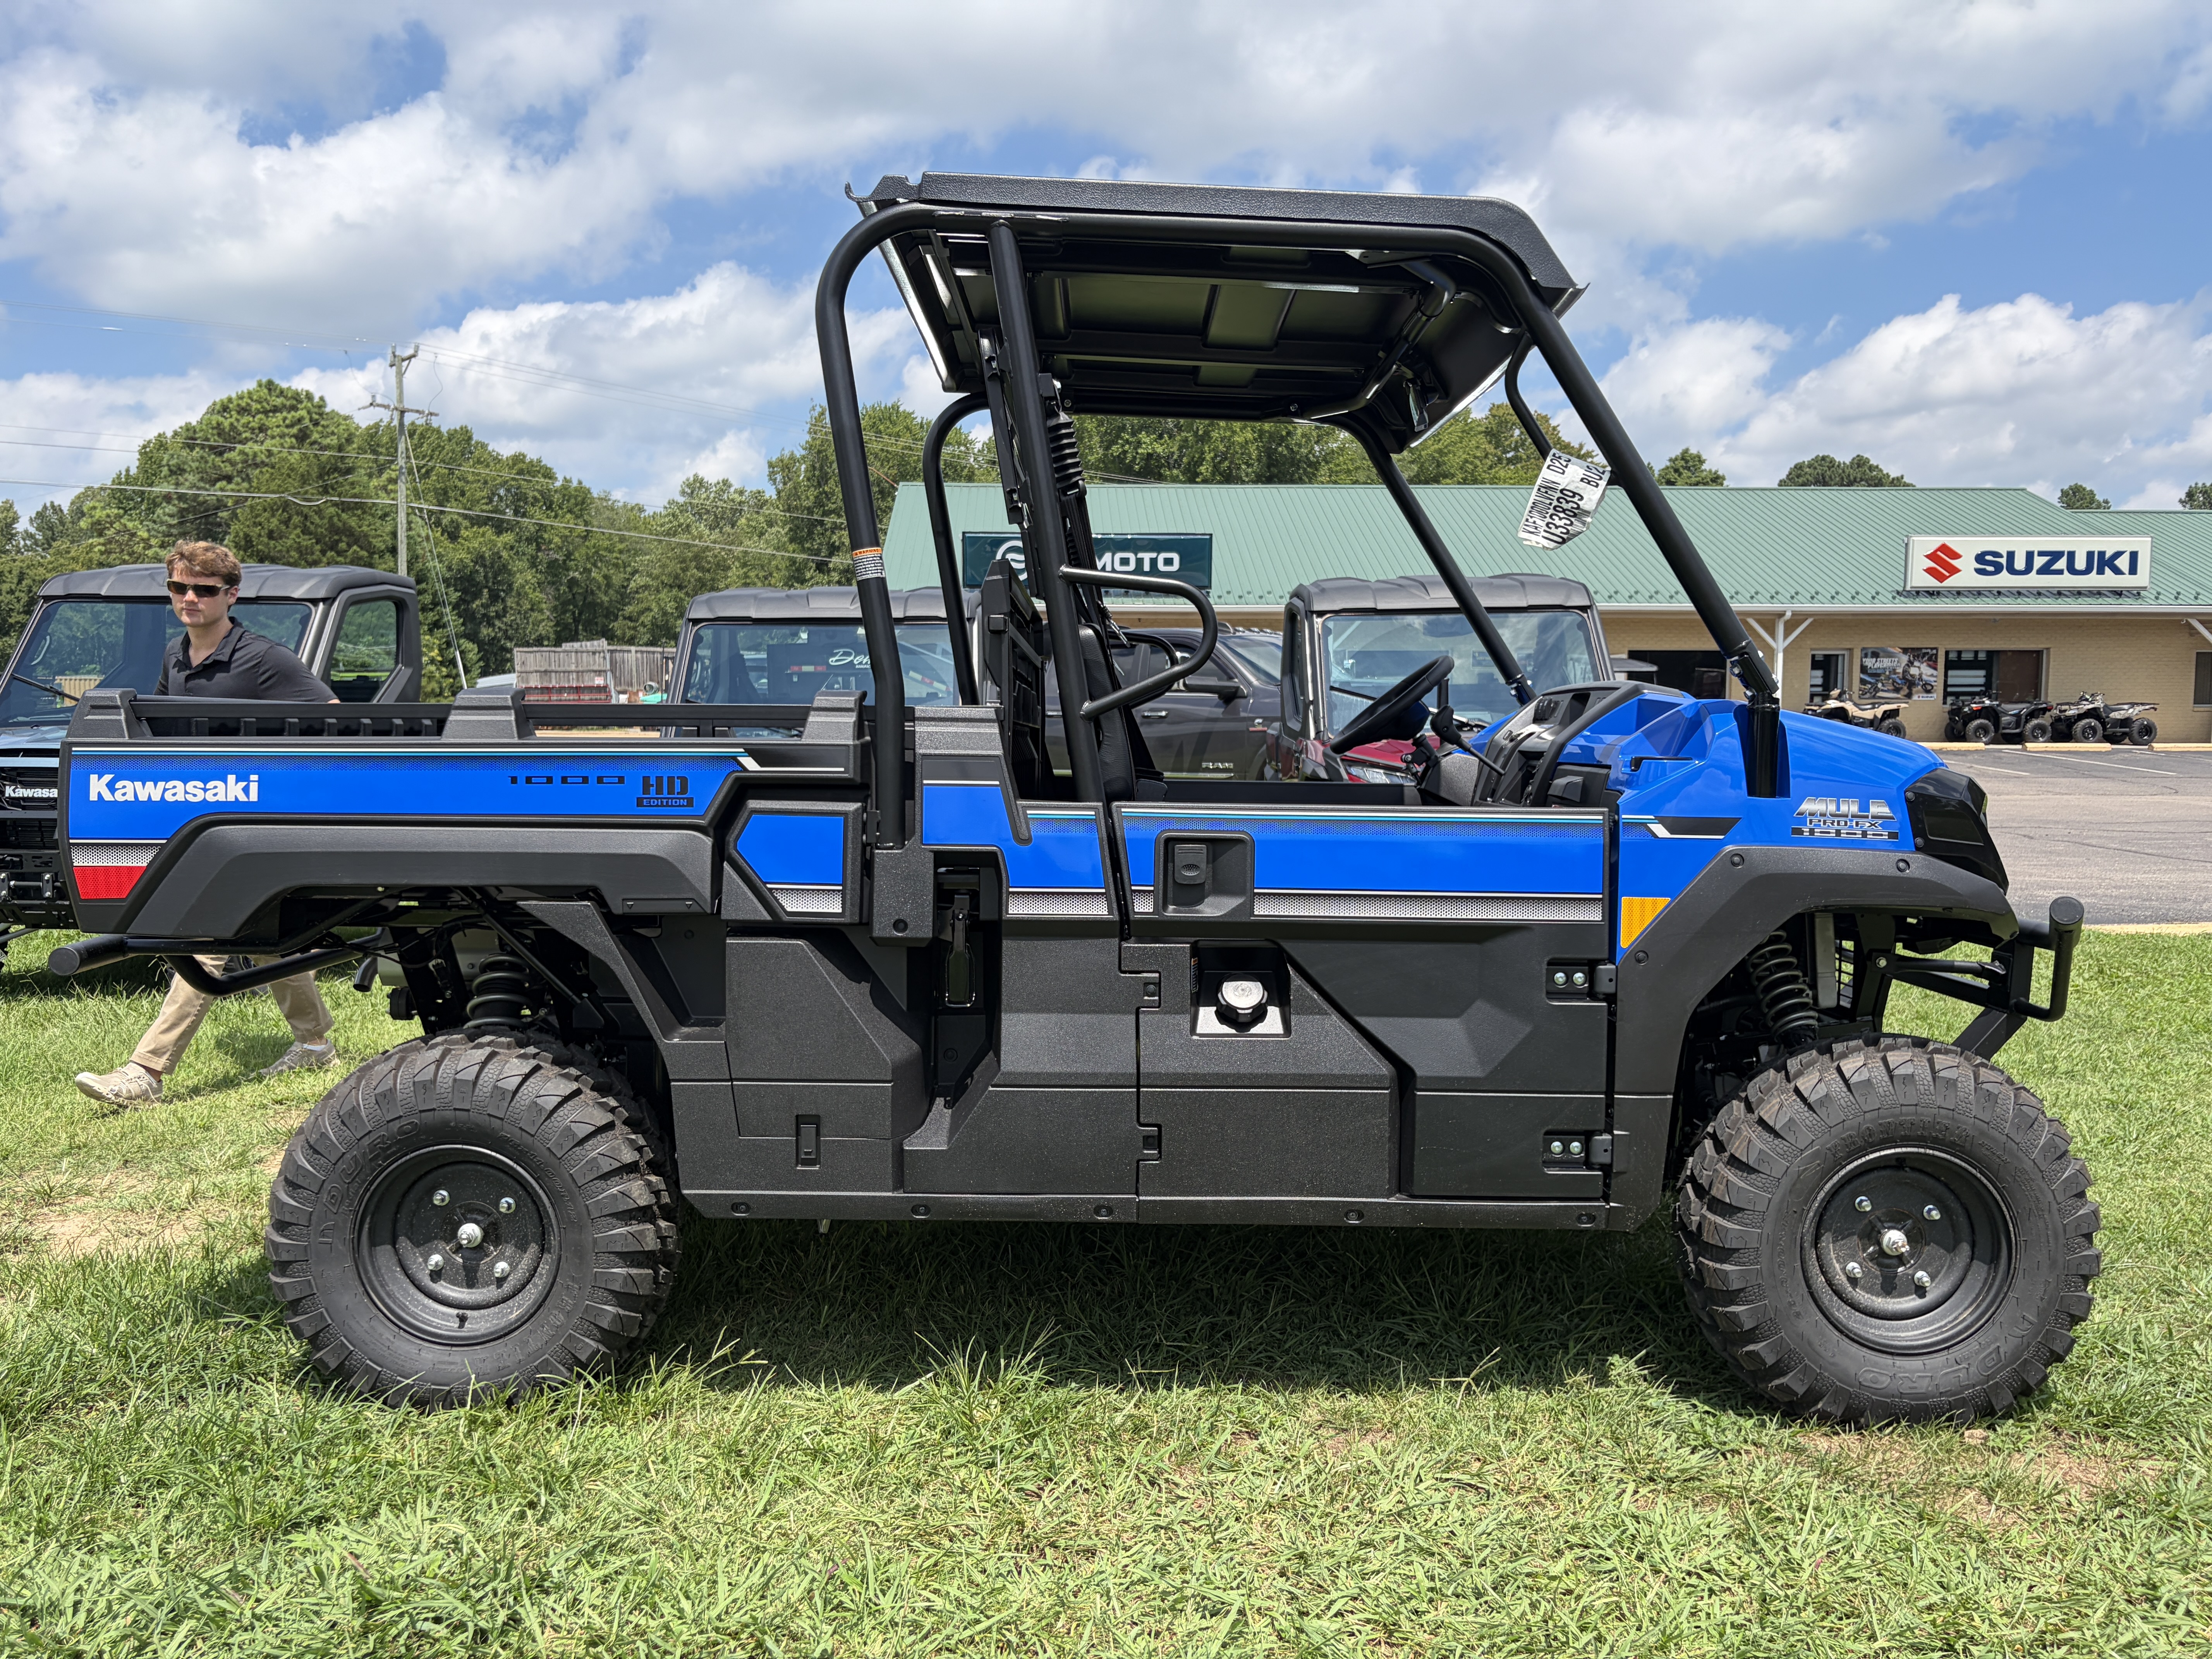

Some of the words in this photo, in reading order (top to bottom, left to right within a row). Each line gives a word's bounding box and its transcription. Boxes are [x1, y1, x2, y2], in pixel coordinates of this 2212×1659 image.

[1541, 488, 1584, 545] U33839
[1580, 465, 1606, 488] BU2
[1973, 550, 2138, 576] SUZUKI
[5, 786, 58, 797] Kawasa
[89, 774, 259, 802] Kawasaki
[508, 776, 625, 785] 1000
[642, 776, 689, 796] HD
[1793, 797, 1896, 821] MULE
[1801, 828, 1888, 839] 1000
[323, 1119, 421, 1215] DURO
[1857, 1344, 2006, 1395] DURO
